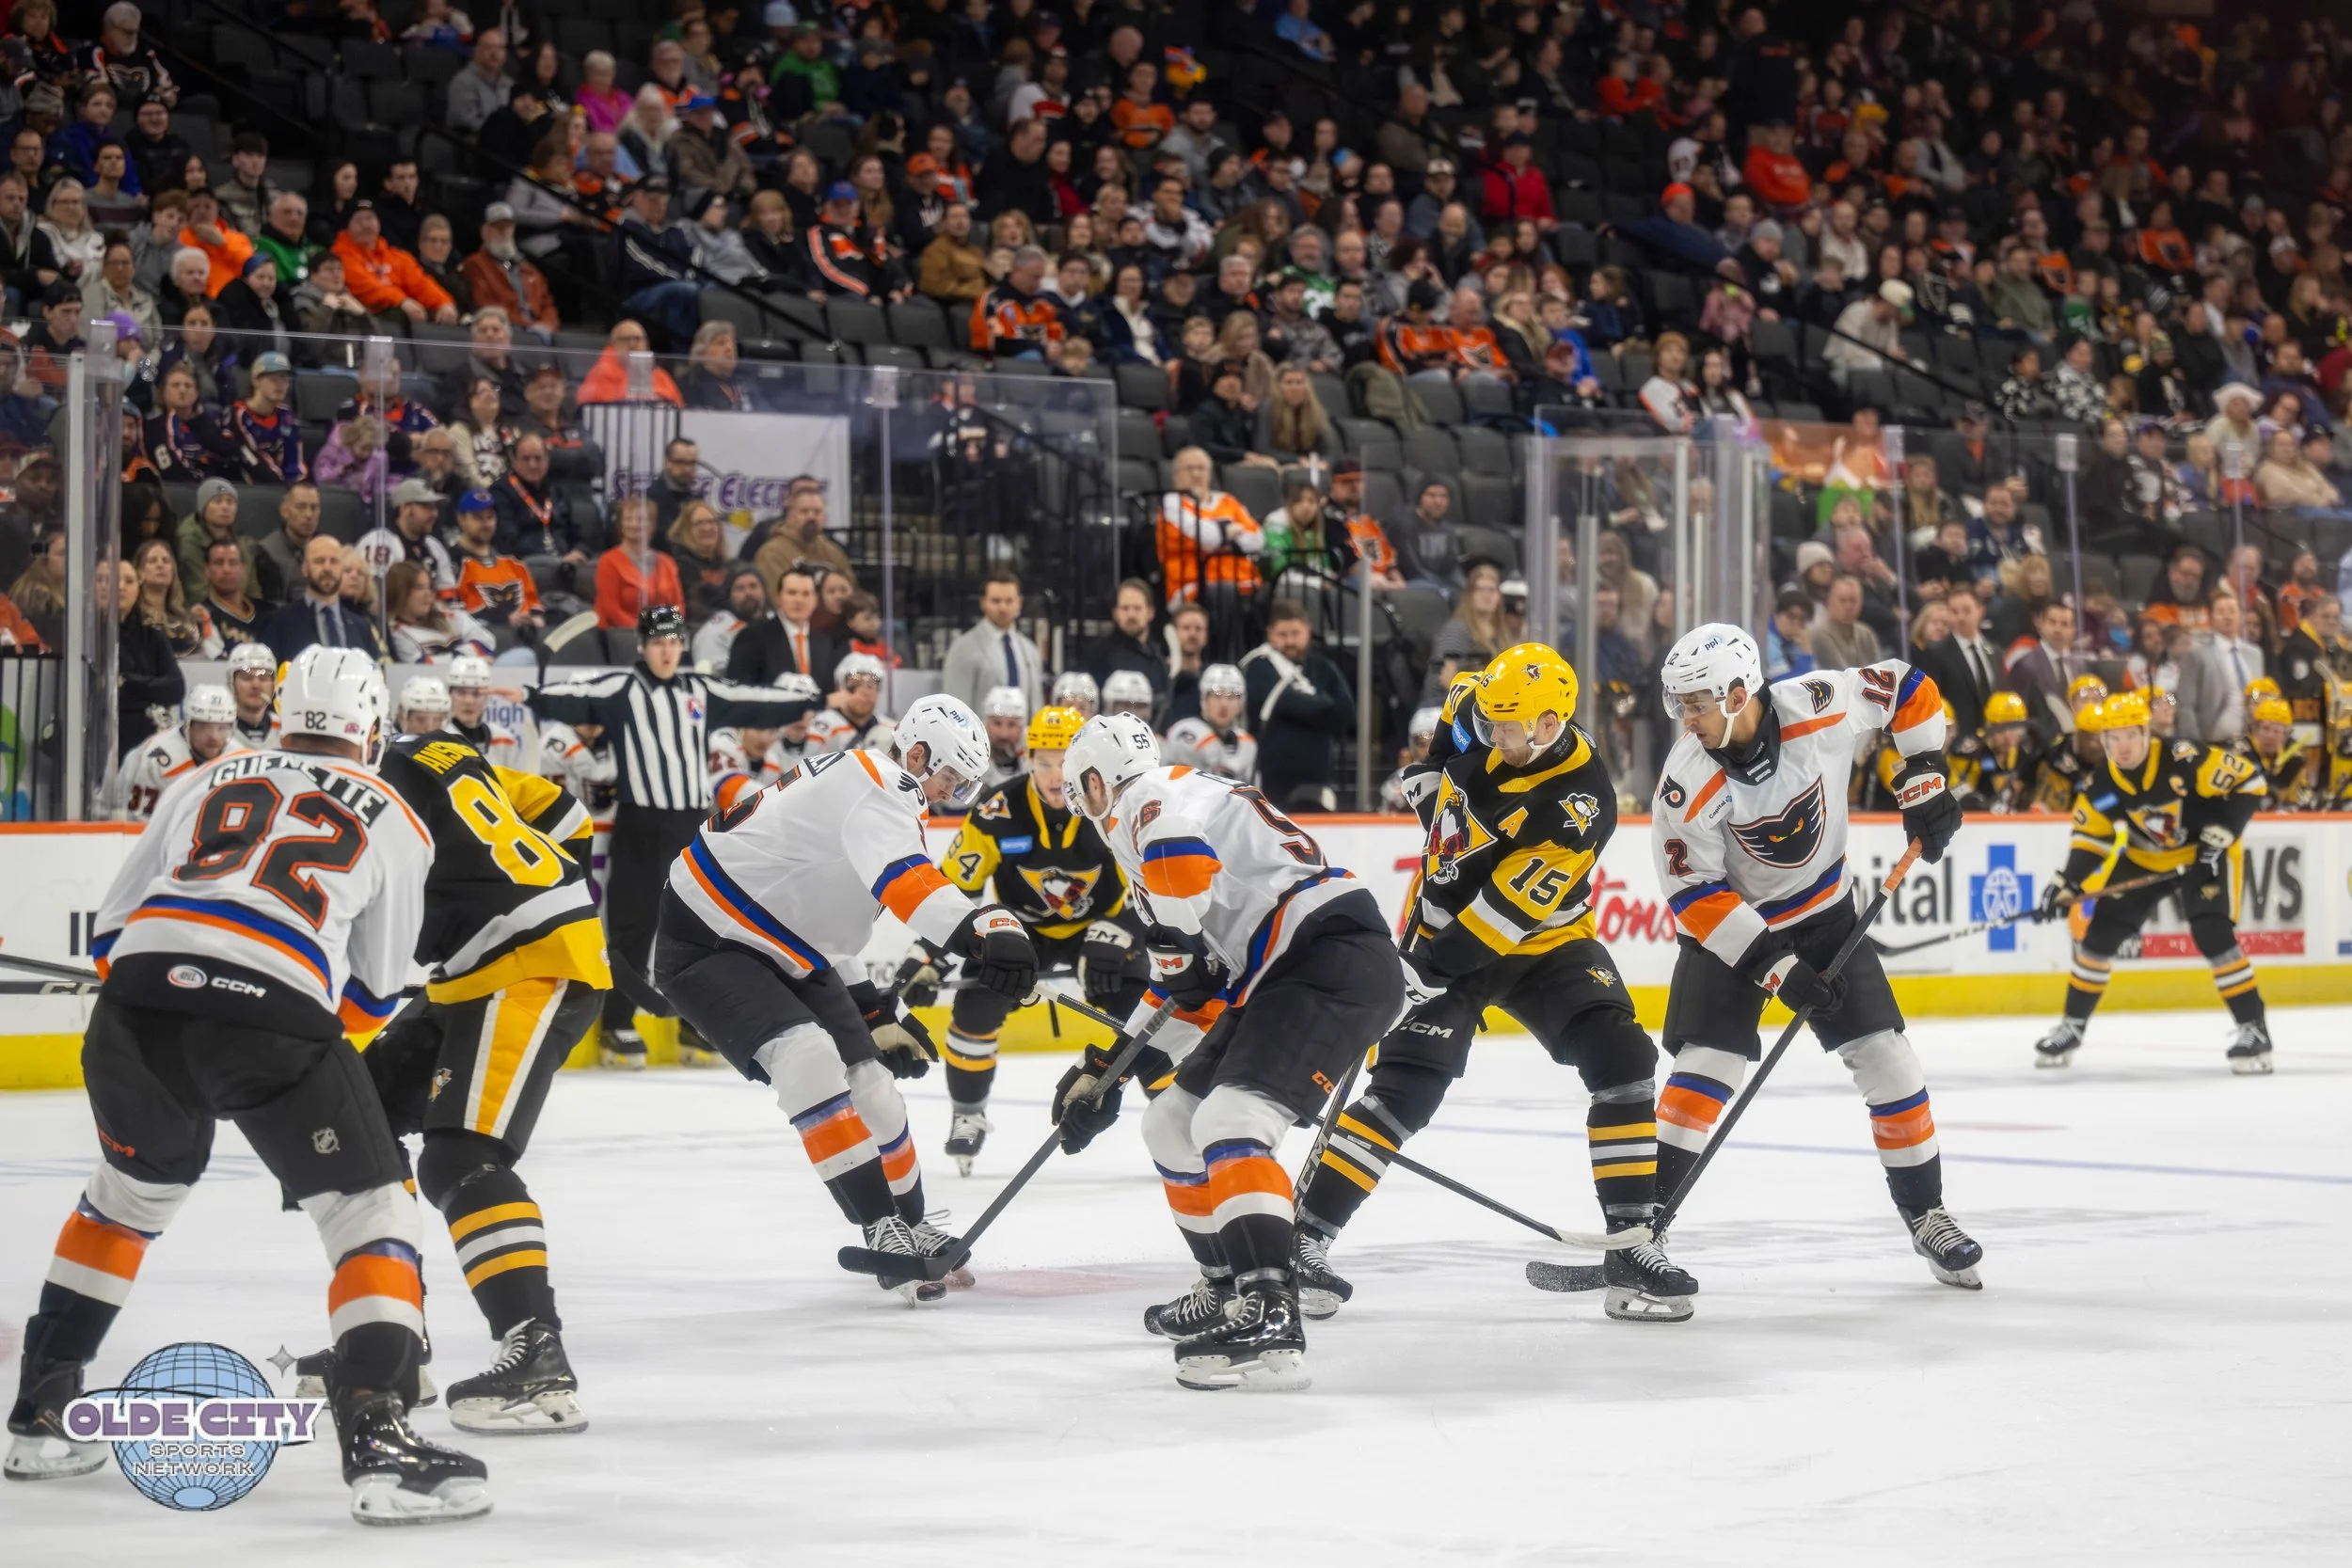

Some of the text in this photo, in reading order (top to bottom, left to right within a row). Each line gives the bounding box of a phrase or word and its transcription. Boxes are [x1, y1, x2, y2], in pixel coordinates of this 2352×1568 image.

[1704, 638, 1719, 651] ppl
[1859, 667, 1897, 712] 12
[305, 710, 327, 731] 82
[949, 709, 964, 723] ppl
[2211, 752, 2246, 792] 52
[448, 774, 579, 887] 8
[1498, 806, 1529, 839] A
[175, 778, 368, 930] 82
[1507, 856, 1572, 907] 15
[211, 976, 266, 998] CCM
[1400, 1022, 1454, 1038] CM
[1311, 1069, 1336, 1095] CC
